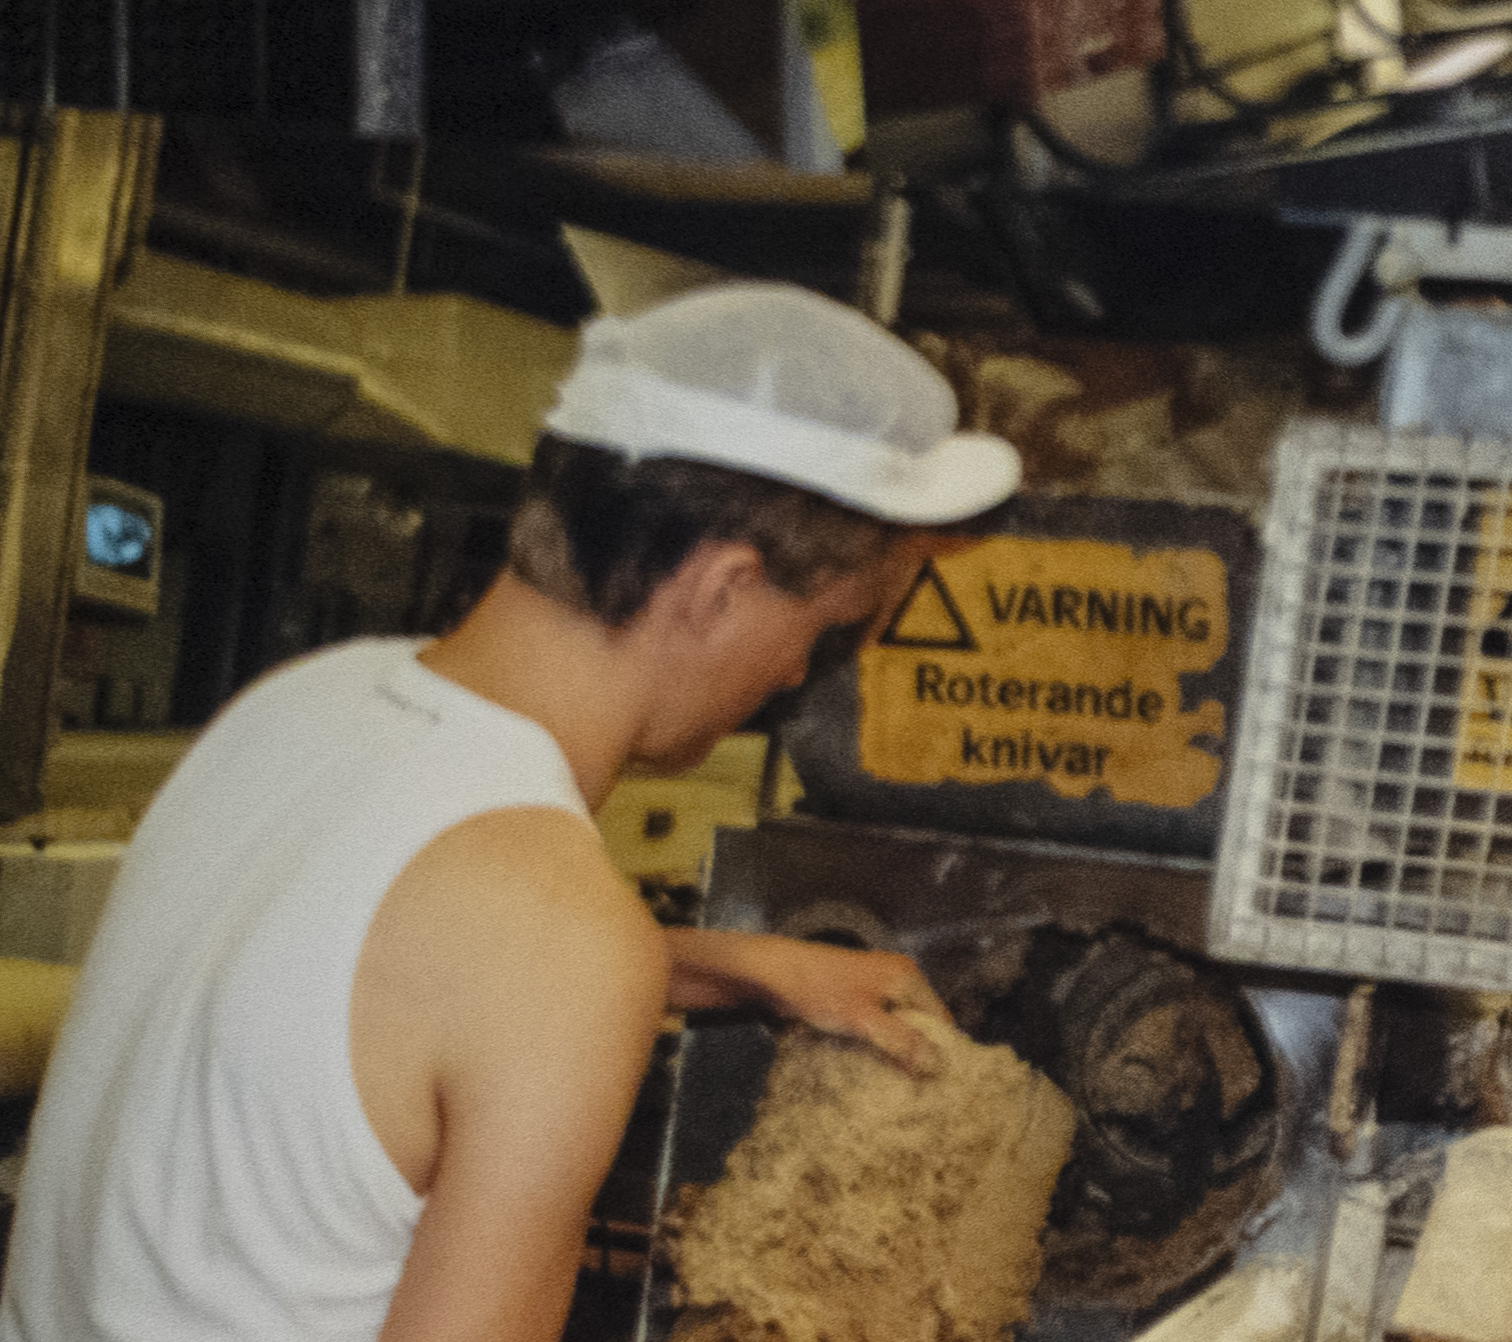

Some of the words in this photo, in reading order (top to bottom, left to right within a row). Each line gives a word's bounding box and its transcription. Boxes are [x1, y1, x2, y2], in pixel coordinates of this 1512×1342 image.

[986, 579, 1211, 643] VARNING
[915, 662, 1165, 724] Roterande
[960, 726, 1112, 776] knivar
